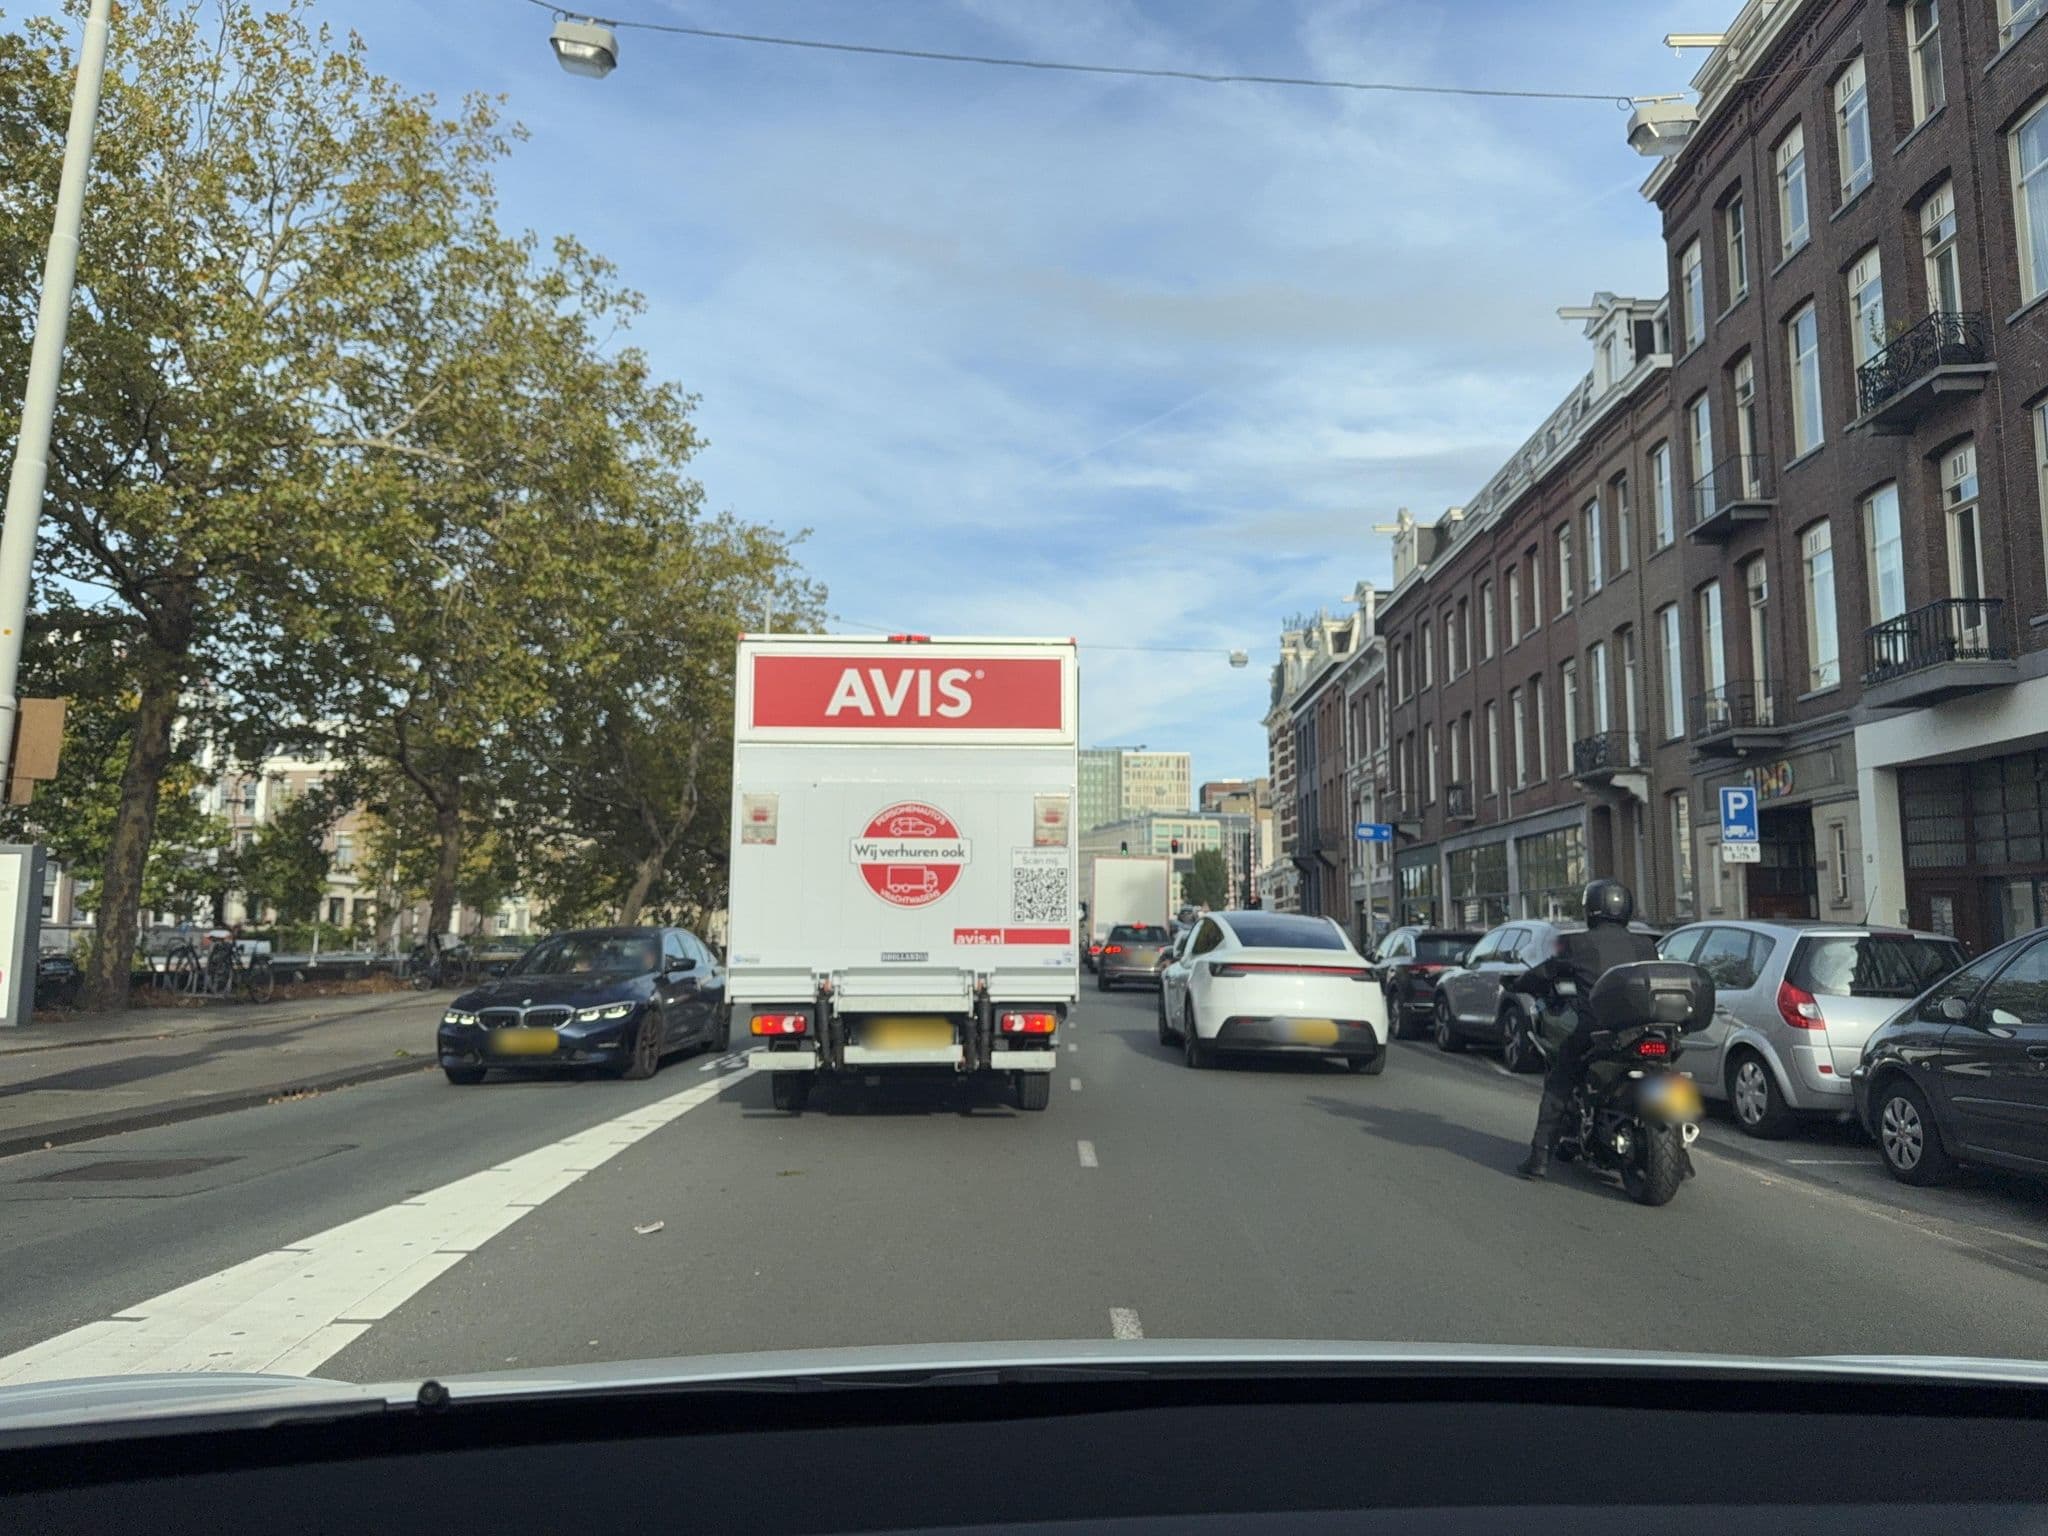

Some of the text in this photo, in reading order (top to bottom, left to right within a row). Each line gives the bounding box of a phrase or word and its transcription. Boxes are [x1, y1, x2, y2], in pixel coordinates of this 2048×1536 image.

[825, 668, 972, 718] AVIS
[1727, 792, 1748, 820] P
[854, 841, 966, 861] Wij verhuren ook
[1022, 856, 1044, 865] Scan
[955, 929, 1005, 945] avis.nl
